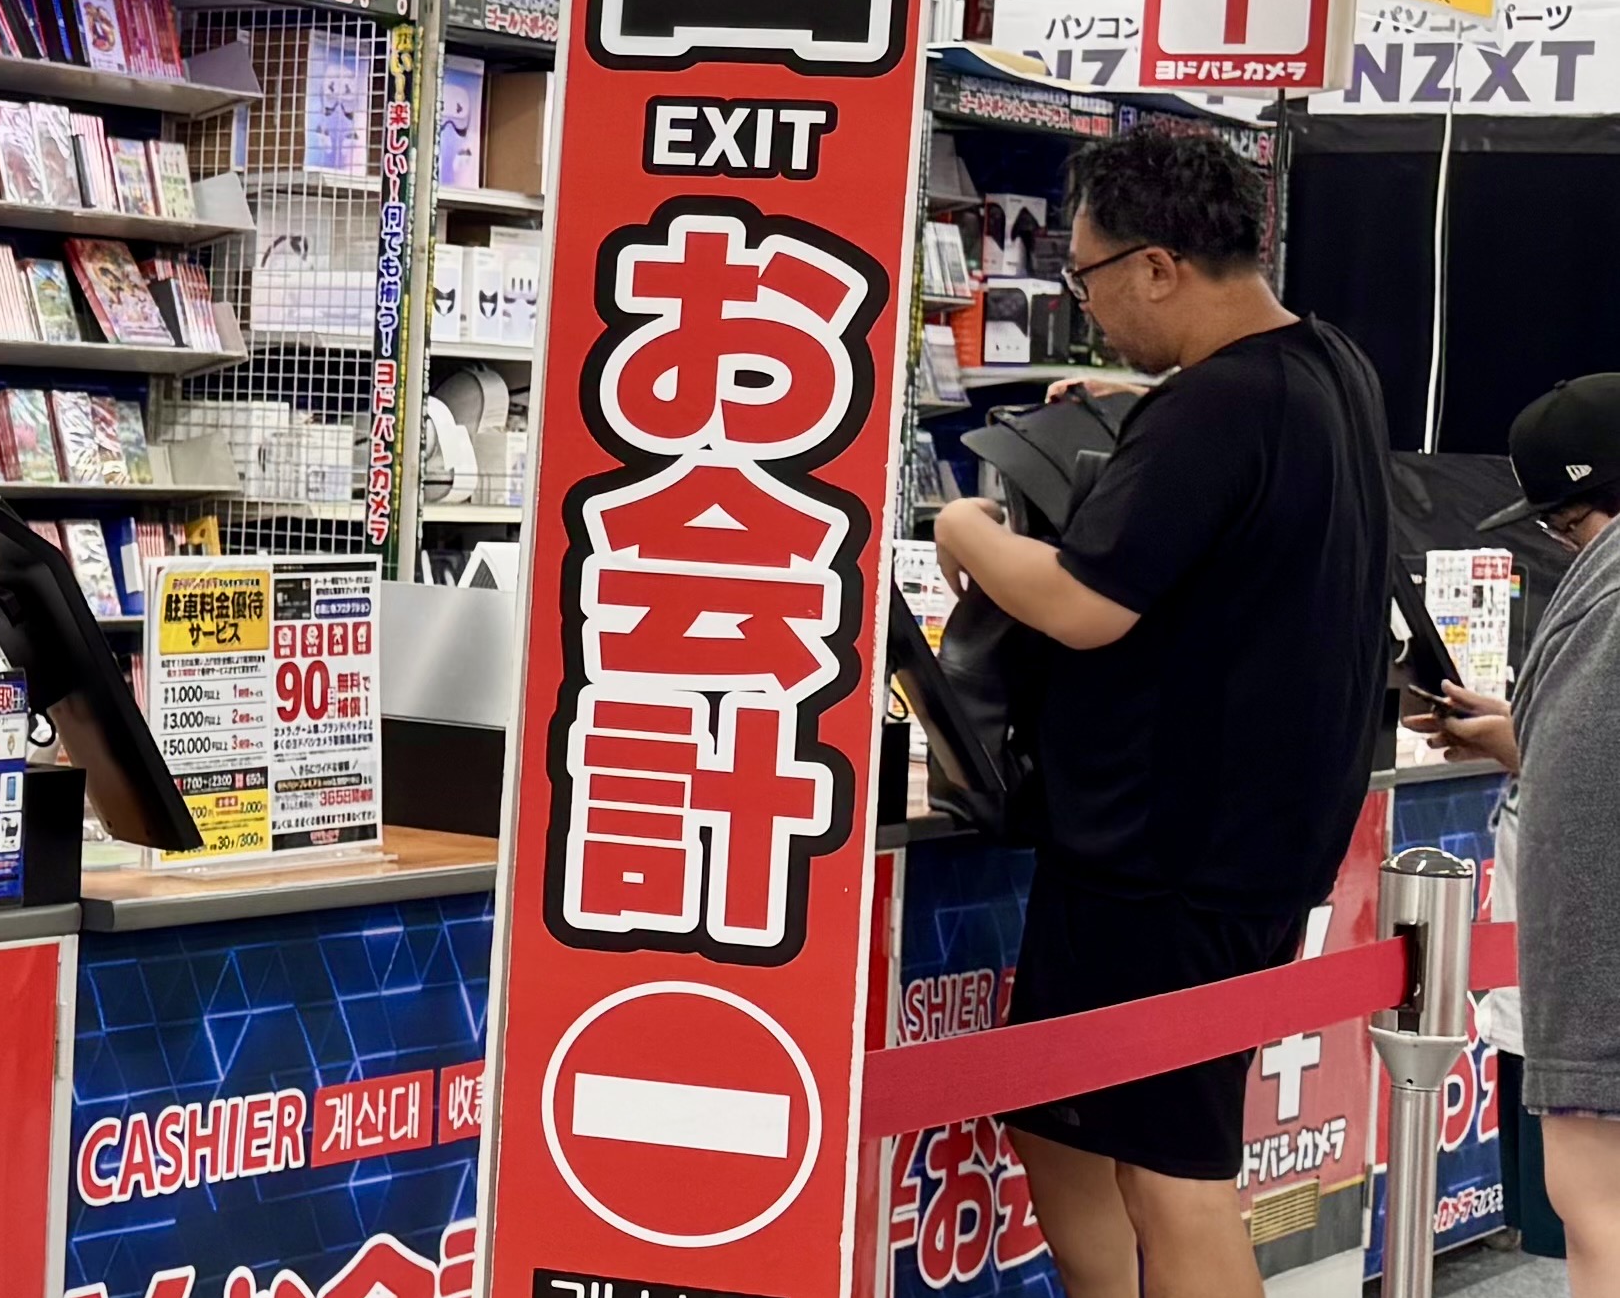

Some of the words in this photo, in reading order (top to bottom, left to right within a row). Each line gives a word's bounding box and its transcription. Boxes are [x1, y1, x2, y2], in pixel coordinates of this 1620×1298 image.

[1154, 61, 1308, 83] ヨドバシカメラ
[1343, 39, 1596, 104] NZXT
[653, 106, 827, 172] EXIT
[562, 215, 868, 943] お会計
[187, 621, 242, 648] サービス
[76, 1089, 307, 1208] CASHIER
[319, 1084, 421, 1155] 계산대
